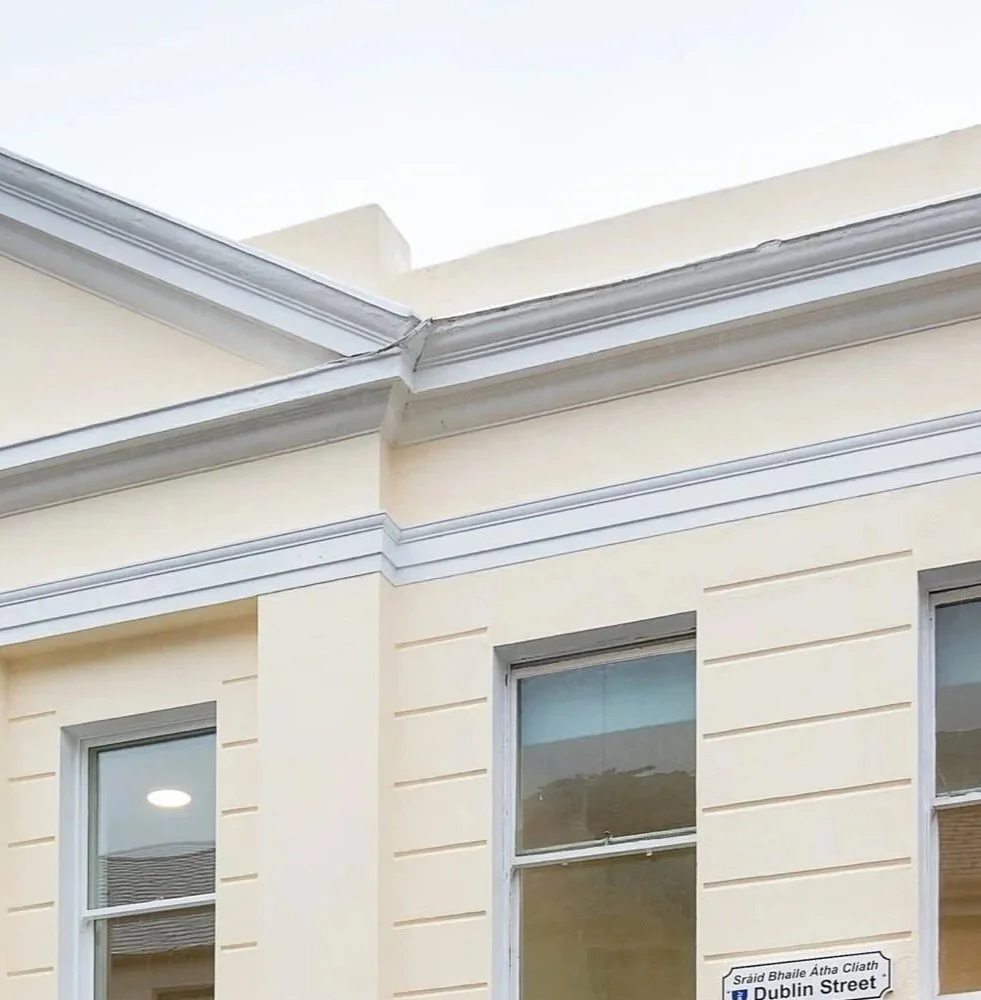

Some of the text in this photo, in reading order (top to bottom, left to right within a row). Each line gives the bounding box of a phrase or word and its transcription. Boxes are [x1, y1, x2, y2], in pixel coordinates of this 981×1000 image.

[733, 960, 879, 985] Sráid Bhaile Átha Cliath
[754, 975, 877, 1000] Dublin Street
